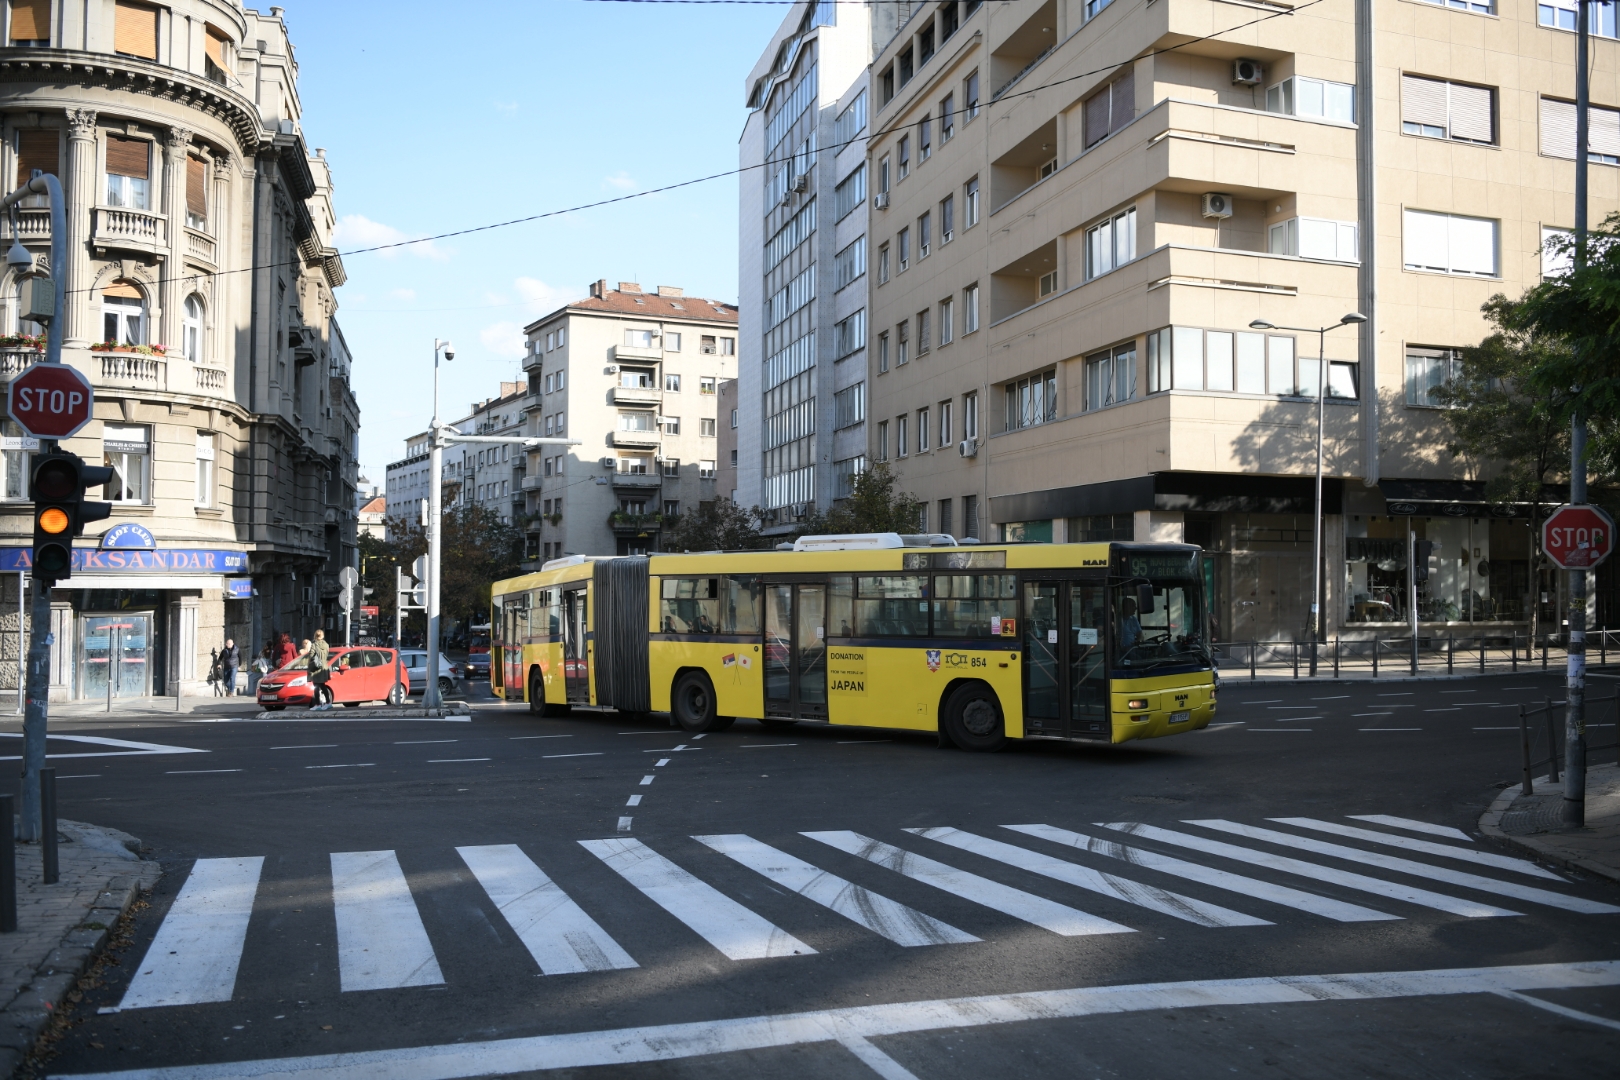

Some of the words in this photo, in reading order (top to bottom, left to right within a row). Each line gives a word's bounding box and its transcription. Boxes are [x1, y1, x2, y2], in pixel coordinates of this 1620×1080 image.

[18, 387, 83, 415] STOP
[107, 526, 129, 546] SLOT
[131, 526, 152, 546] CLUB
[1550, 527, 1604, 548] STOP
[14, 550, 215, 569] AEKSANDAR
[1347, 541, 1404, 560] LIVING
[1131, 557, 1148, 577] 95
[1150, 557, 1166, 567] NOVI
[1158, 567, 1176, 577] BLOK
[830, 652, 864, 661] DONATION
[971, 657, 987, 668] 854
[830, 680, 864, 692] JAPAN
